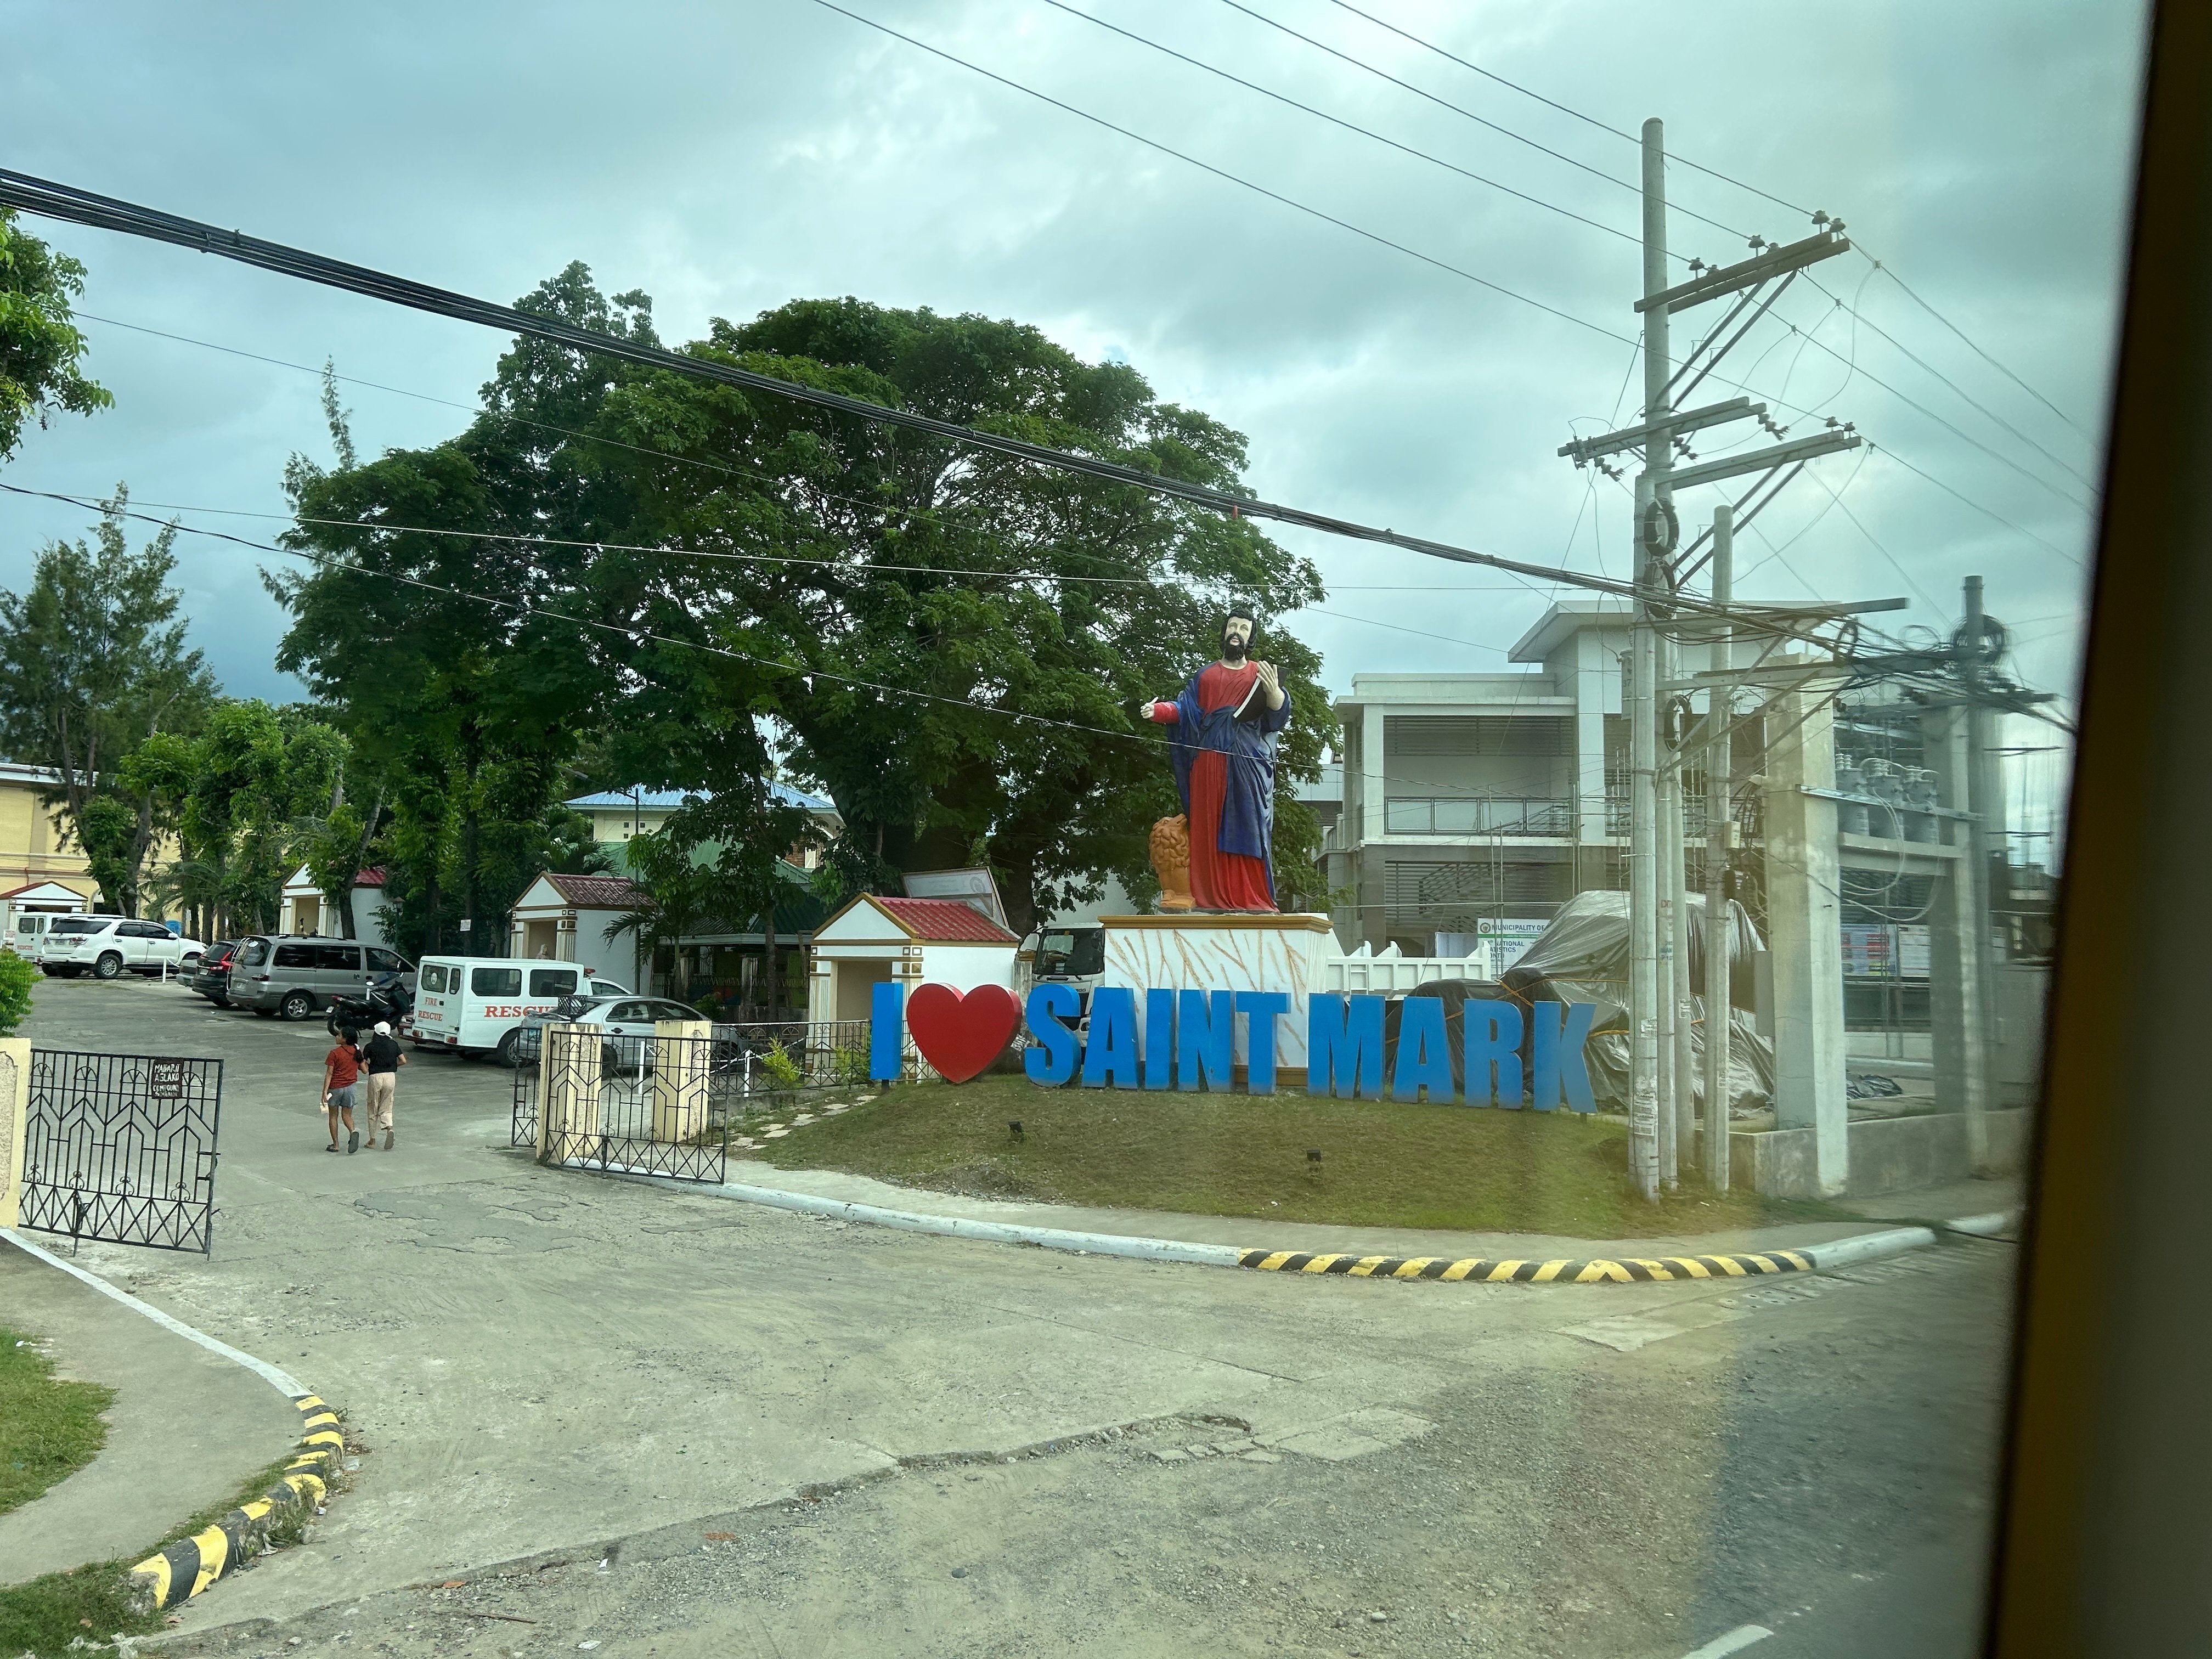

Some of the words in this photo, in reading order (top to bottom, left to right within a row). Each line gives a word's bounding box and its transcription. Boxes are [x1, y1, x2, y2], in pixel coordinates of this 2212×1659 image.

[425, 997, 438, 1007] FIRE
[417, 1010, 443, 1022] RESCUE
[870, 982, 903, 1080] I
[1025, 984, 1290, 1094] SAINT
[1308, 994, 1597, 1113] MARK
